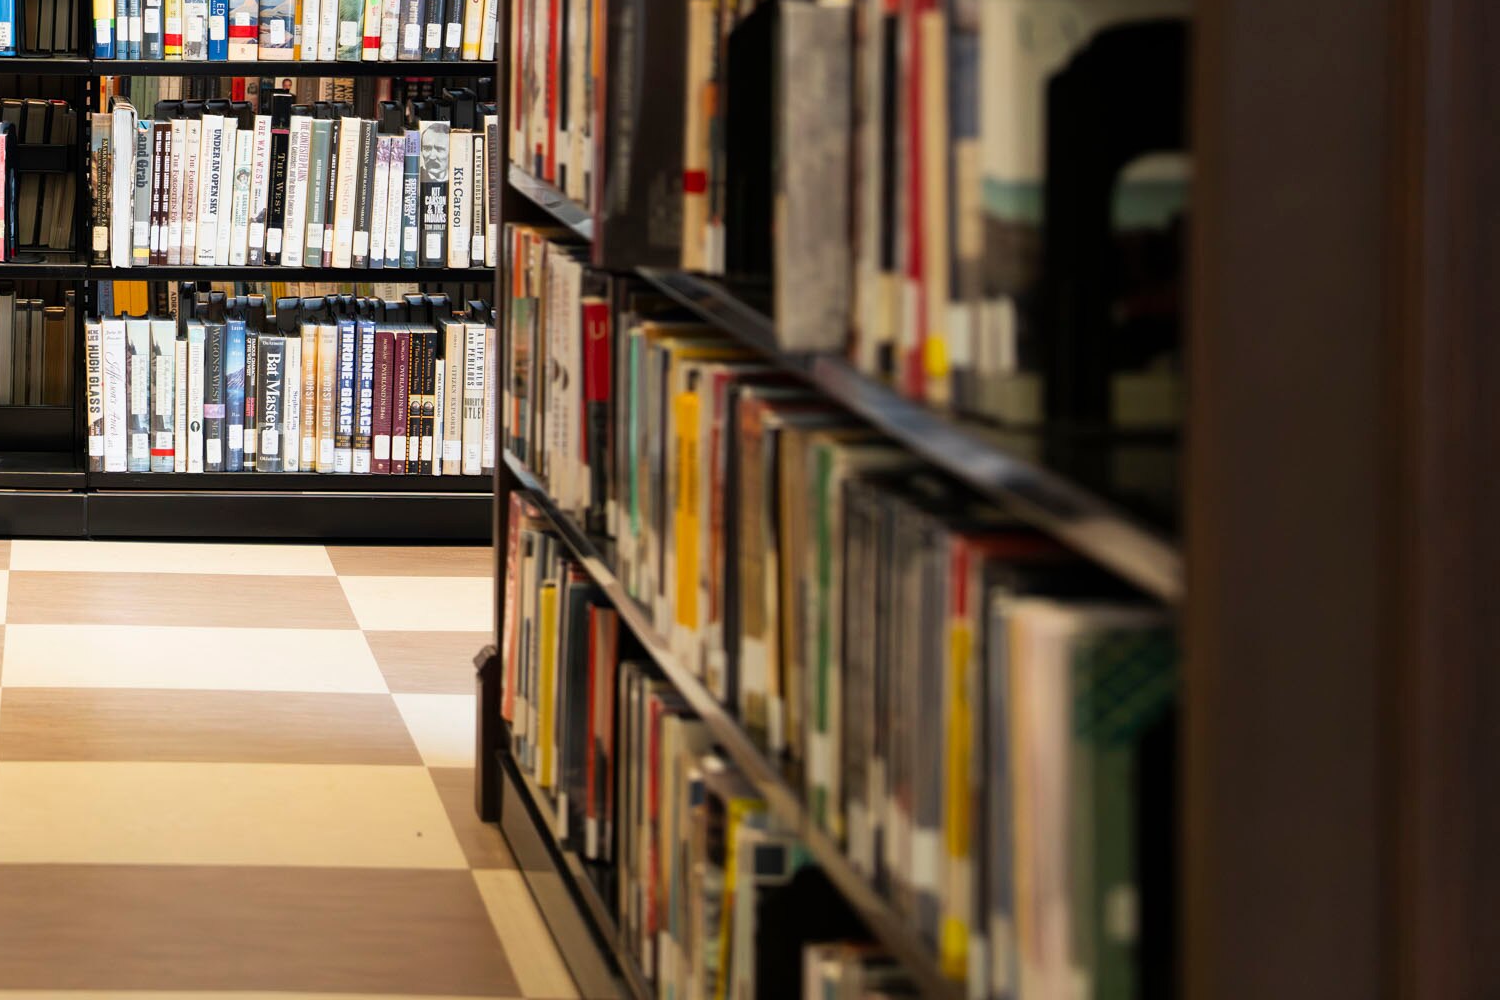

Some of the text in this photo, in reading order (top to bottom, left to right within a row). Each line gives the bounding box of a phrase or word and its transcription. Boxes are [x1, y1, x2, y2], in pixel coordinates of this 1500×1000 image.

[209, 129, 222, 215] UNDER AN OPEN SKY
[255, 120, 266, 184] THE WAY WEST
[454, 168, 464, 185] Kit
[88, 345, 100, 413] HUGH GLASS
[212, 327, 221, 402] WAGONS WEST
[341, 325, 354, 379] THRONE
[476, 343, 484, 361] LIFE
[380, 364, 388, 397] OVERLAND
[341, 388, 355, 434] GRACE
